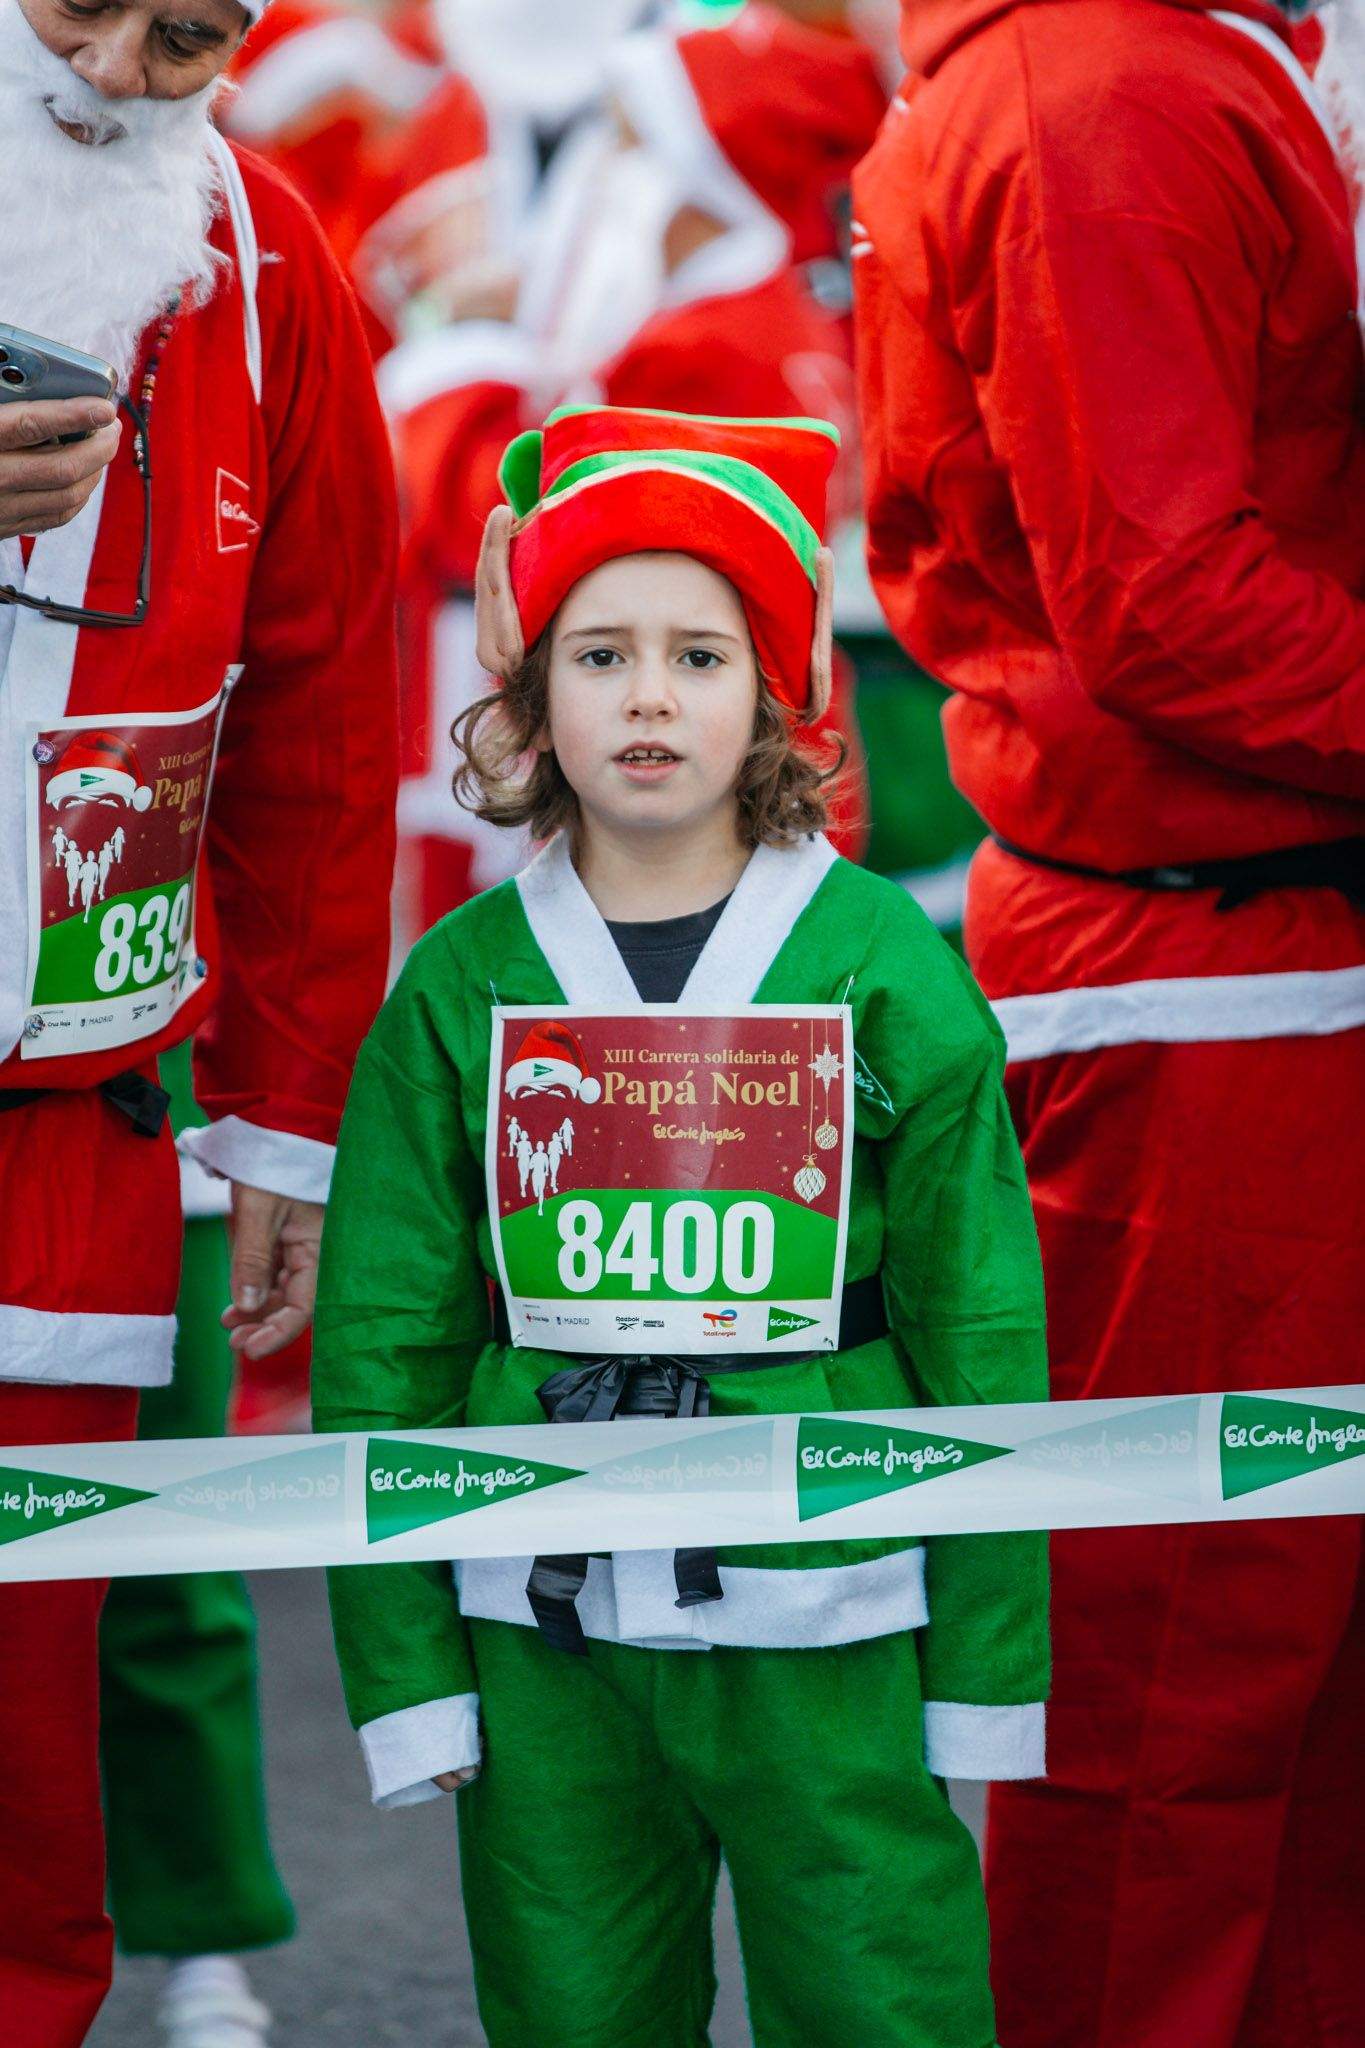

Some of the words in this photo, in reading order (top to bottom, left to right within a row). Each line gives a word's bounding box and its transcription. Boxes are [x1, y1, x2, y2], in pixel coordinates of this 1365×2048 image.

[159, 753, 181, 771] XIII
[89, 1014, 114, 1025] MADRID
[604, 1049, 634, 1063] XIII
[638, 1049, 700, 1064] Carrera
[704, 1049, 777, 1065] solidaria
[780, 1049, 799, 1064] de
[601, 1070, 698, 1116] Papá
[710, 1070, 800, 1106] Noel
[653, 1123, 667, 1139] El
[667, 1124, 699, 1140] Corte
[556, 1199, 776, 1295] 8400
[564, 1317, 590, 1326] MADRID
[1224, 1424, 1248, 1448] El
[1248, 1424, 1304, 1447] Corte
[1306, 1416, 1365, 1454] Ingle
[801, 1445, 825, 1470] El
[826, 1445, 881, 1469] Corte
[883, 1438, 964, 1476] Inglés
[370, 1467, 394, 1491] El
[396, 1467, 451, 1491] Corte
[454, 1460, 536, 1498] Inglés
[24, 1482, 106, 1519] Inglés
